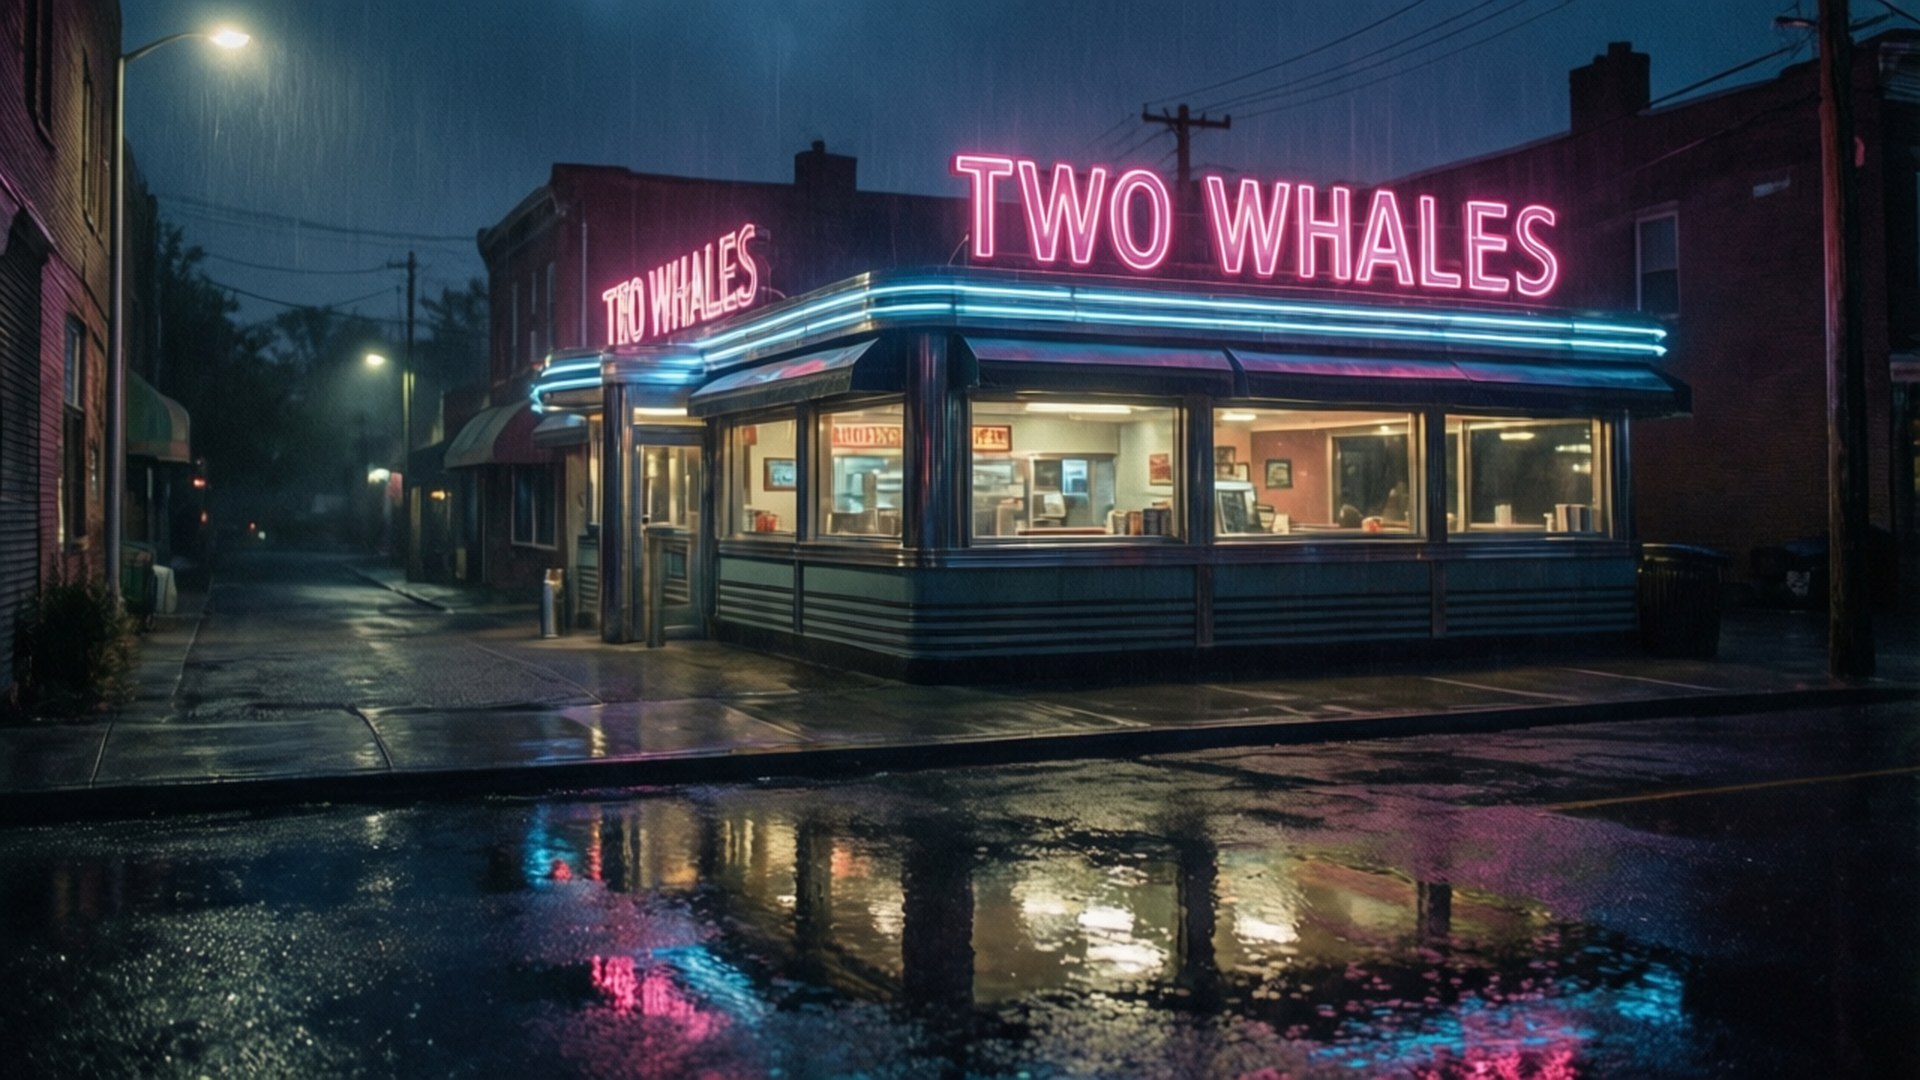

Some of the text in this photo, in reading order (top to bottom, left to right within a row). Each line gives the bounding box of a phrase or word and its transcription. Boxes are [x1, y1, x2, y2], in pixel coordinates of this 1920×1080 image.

[648, 223, 758, 337] WHALES
[955, 154, 1560, 298] TWO WHALES
